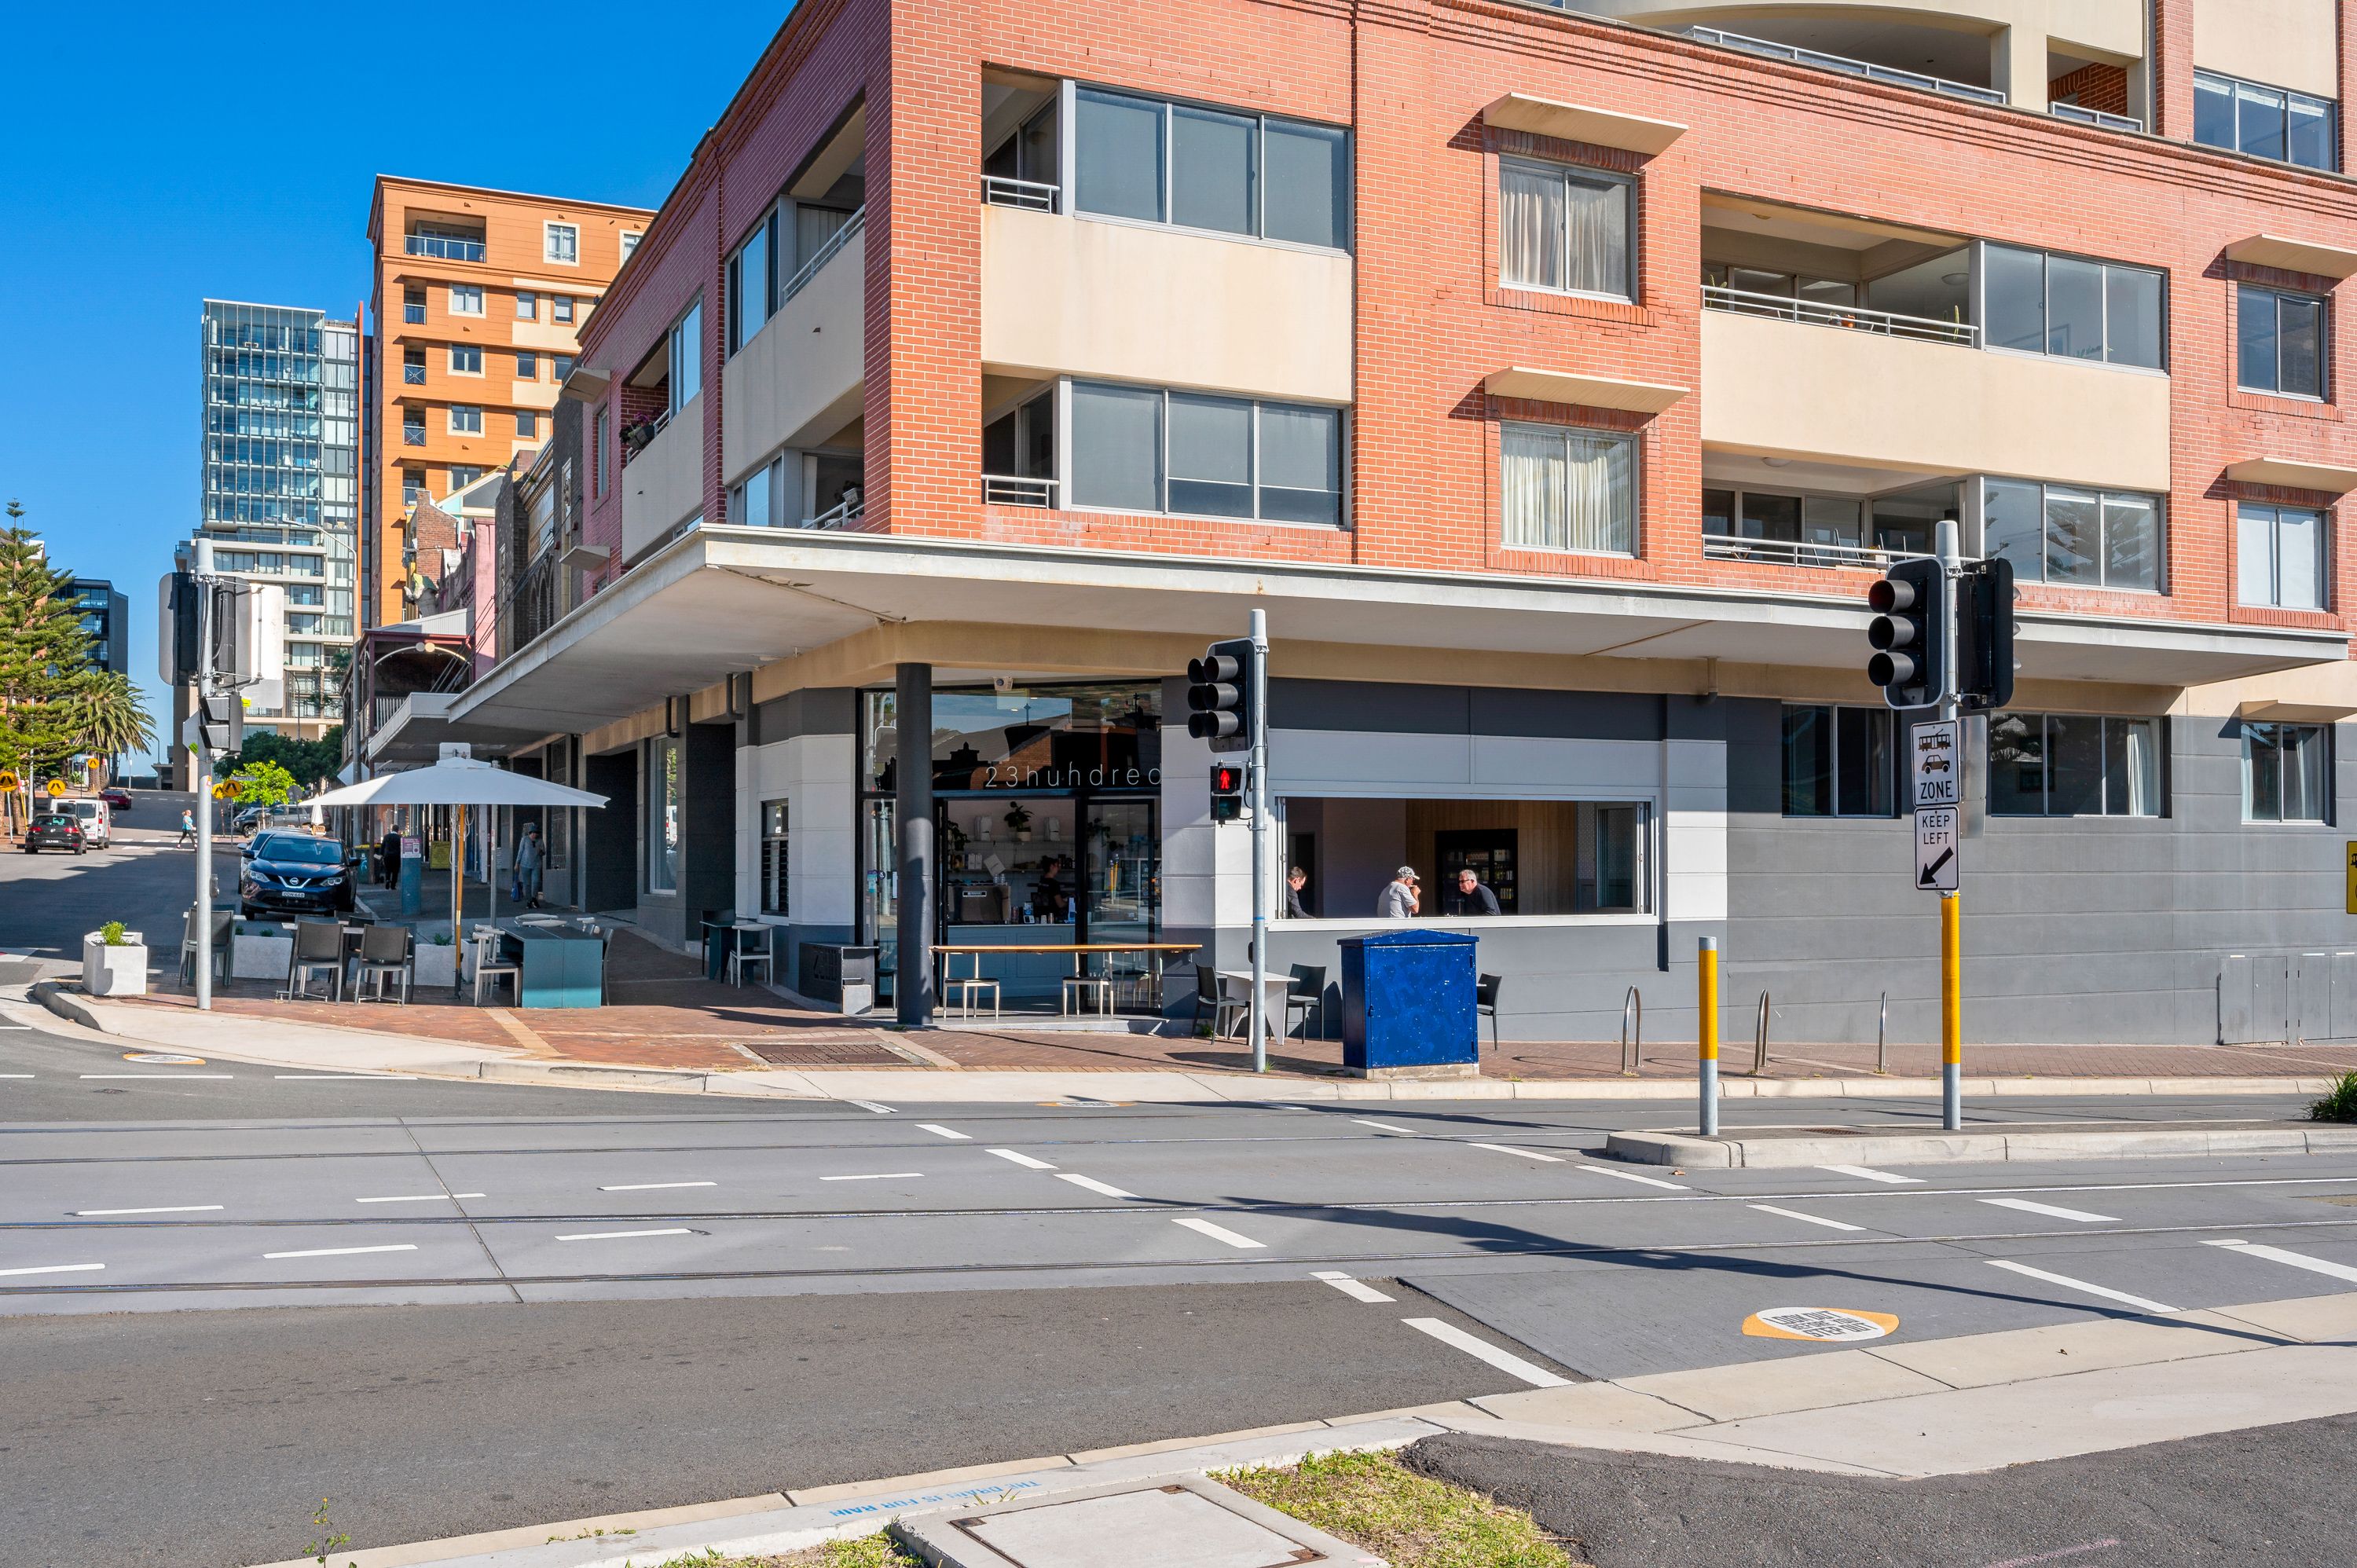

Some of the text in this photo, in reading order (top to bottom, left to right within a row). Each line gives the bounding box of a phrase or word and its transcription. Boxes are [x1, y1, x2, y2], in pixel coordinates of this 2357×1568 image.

[1920, 780, 1953, 799] ZONE
[1922, 815, 1950, 828] KEEP
[1923, 832, 1949, 845] LEFT
[1762, 1310, 1842, 1325] LOOK OUT
[1802, 1323, 1879, 1338] STEP OUT
[1005, 1479, 1042, 1489] THE
[880, 1498, 920, 1508] FOR
[829, 1504, 879, 1517] RAIN
